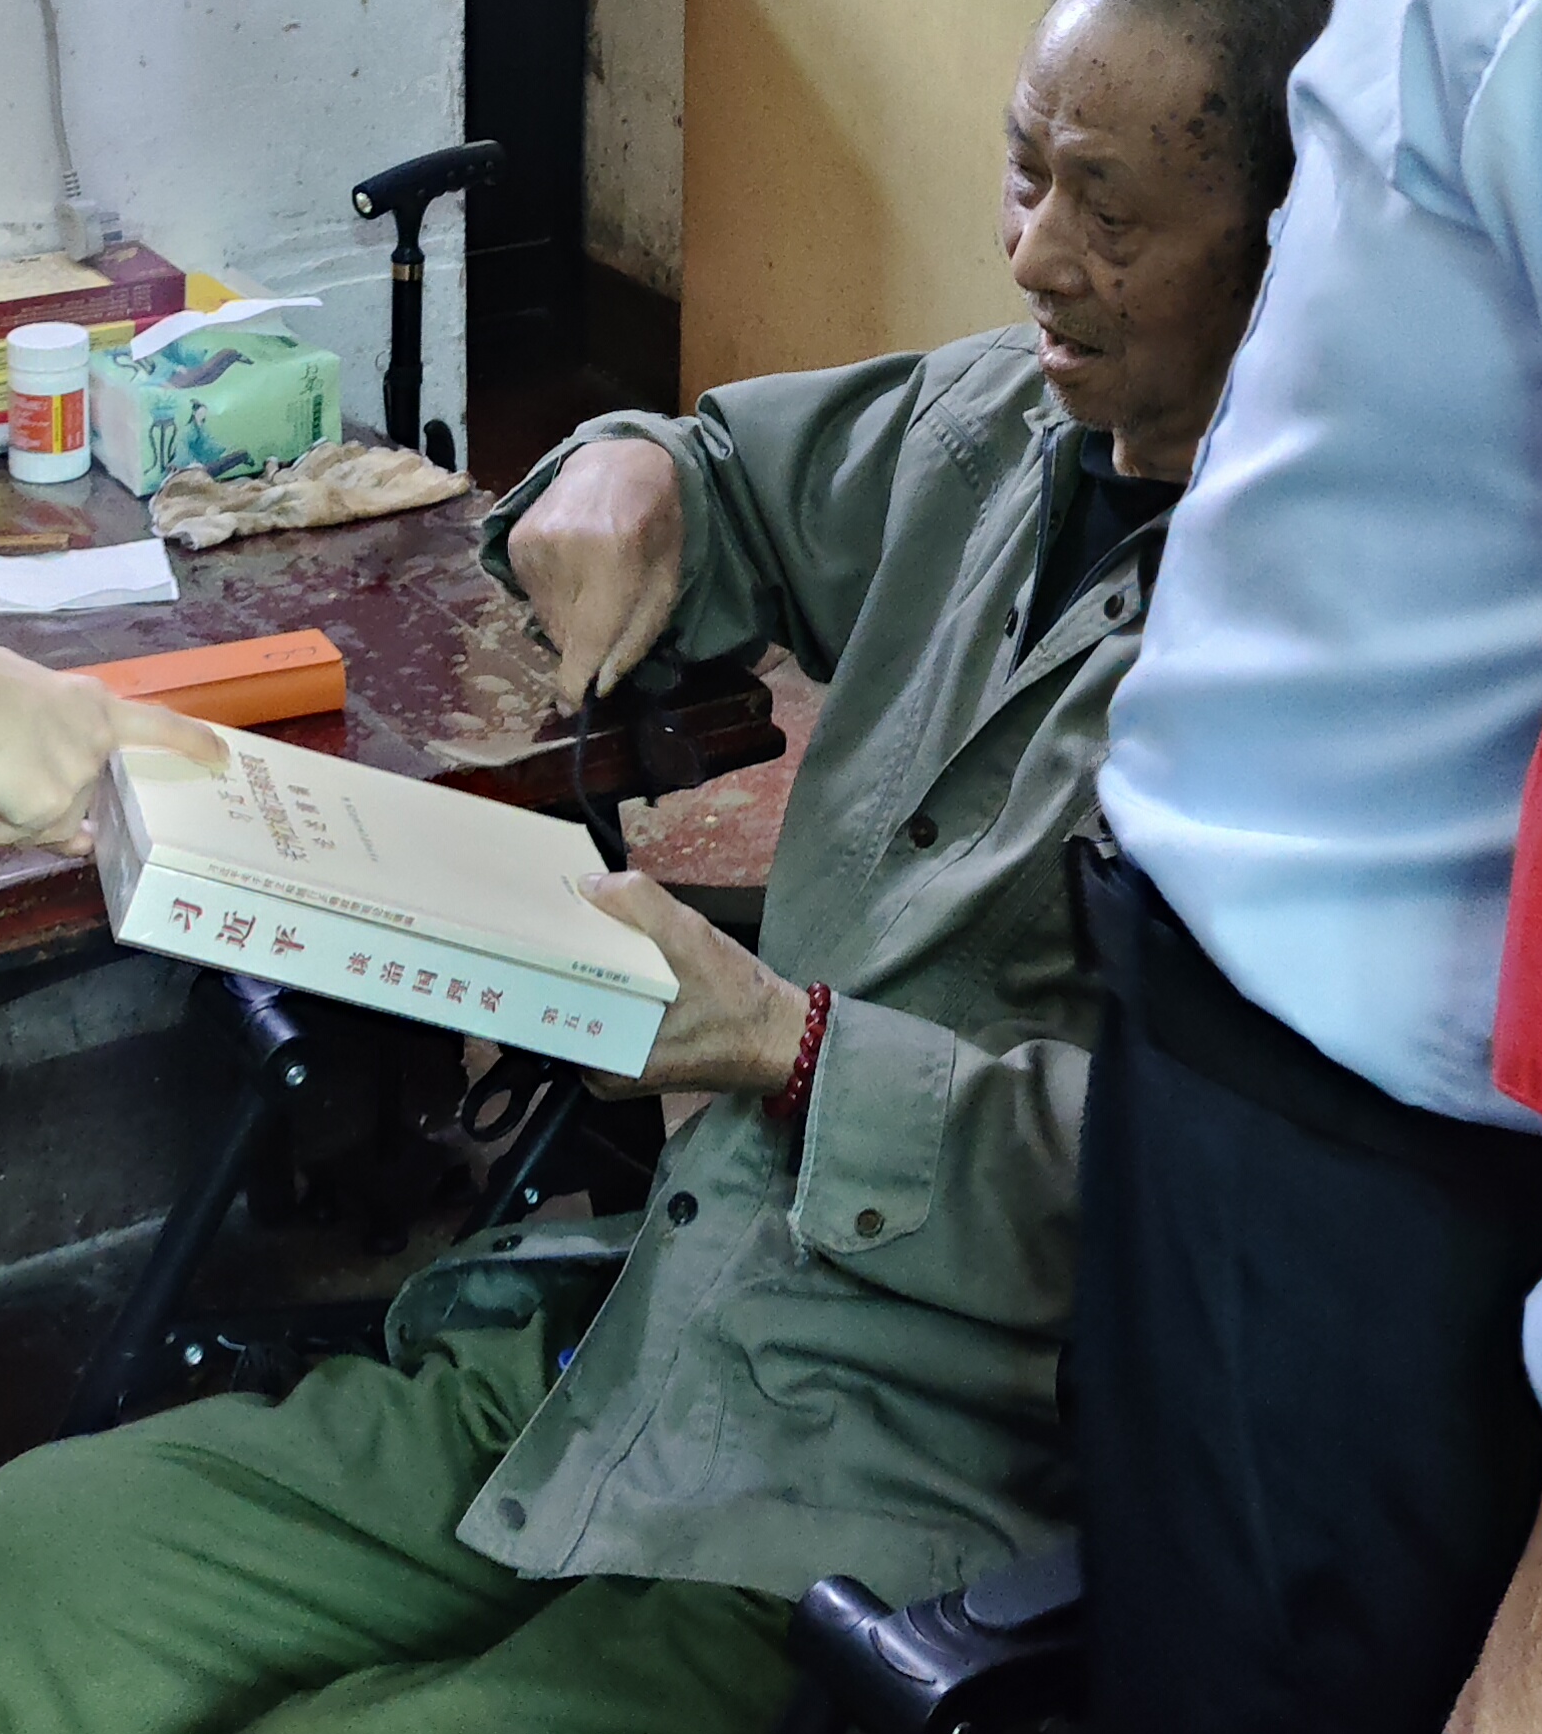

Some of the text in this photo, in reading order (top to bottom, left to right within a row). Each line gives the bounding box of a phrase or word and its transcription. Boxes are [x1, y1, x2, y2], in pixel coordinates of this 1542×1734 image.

[168, 897, 305, 958] 习近平
[346, 952, 504, 1014] 谈治国理政
